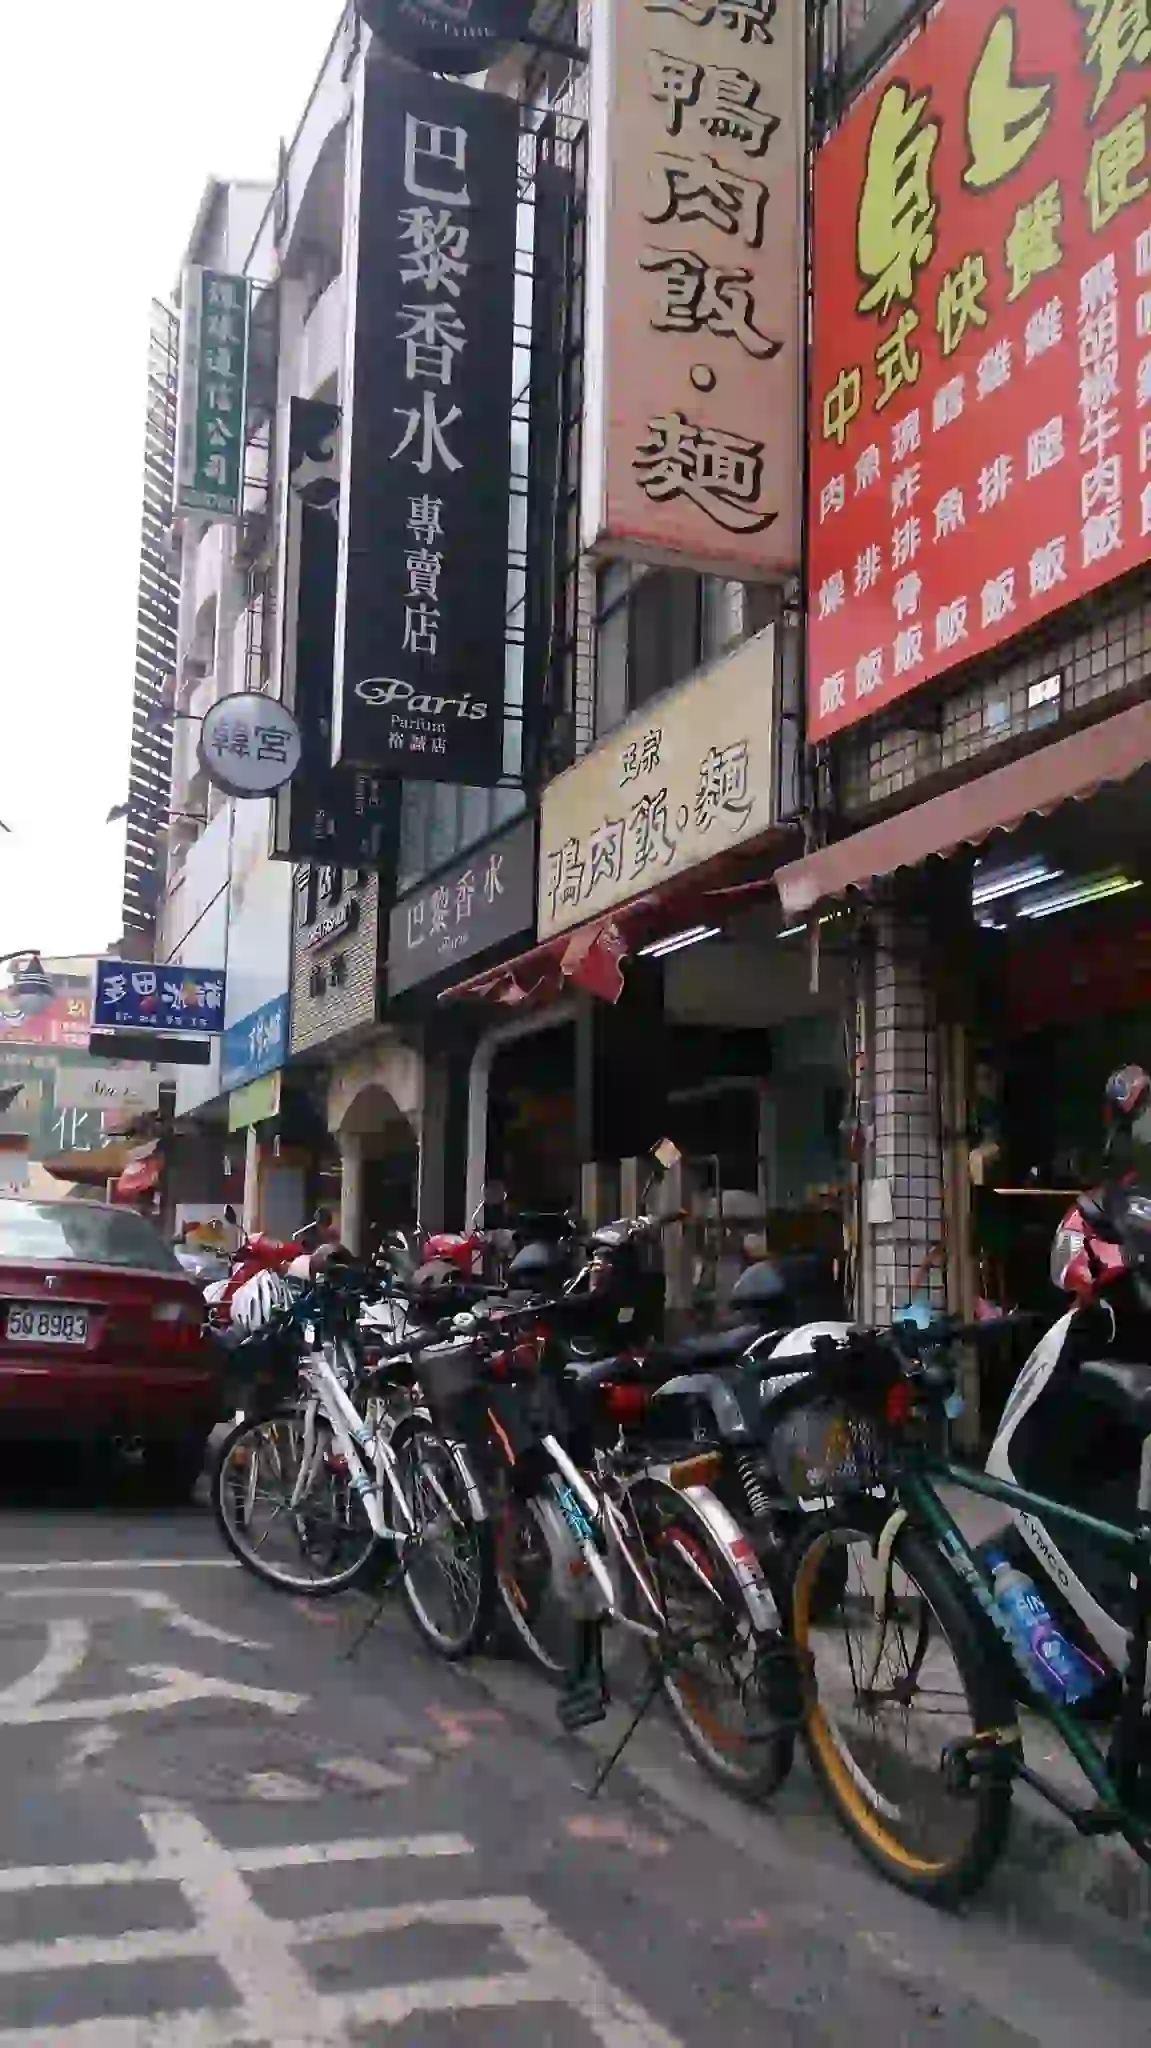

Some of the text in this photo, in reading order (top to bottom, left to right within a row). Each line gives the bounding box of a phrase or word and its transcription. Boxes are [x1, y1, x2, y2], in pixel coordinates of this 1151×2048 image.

[389, 111, 471, 475] 巴黎香水
[401, 494, 444, 656] 專賣店
[354, 677, 489, 719] Paris
[391, 714, 446, 735] Parfum
[407, 853, 504, 949] 巴黎香水
